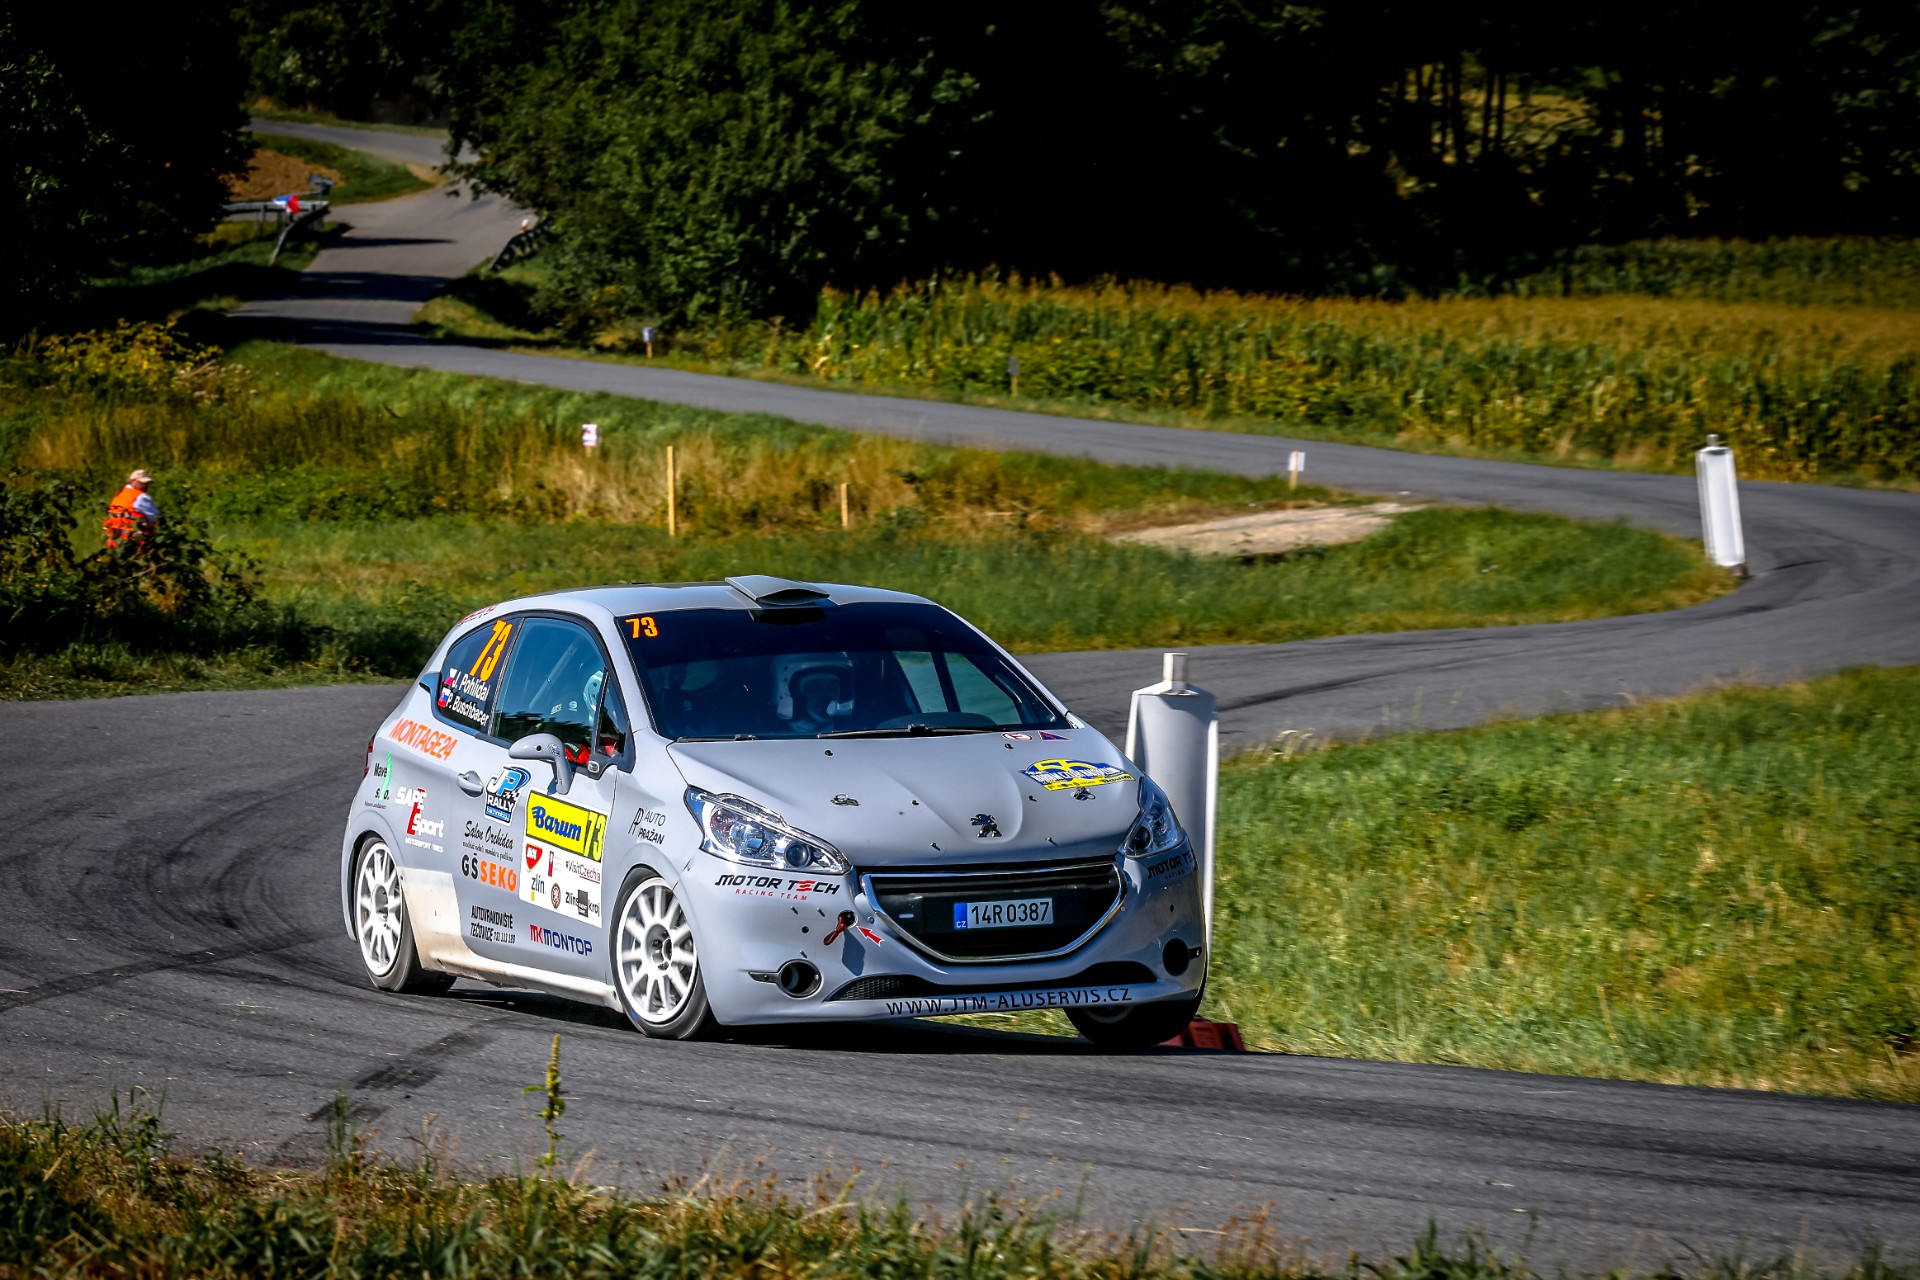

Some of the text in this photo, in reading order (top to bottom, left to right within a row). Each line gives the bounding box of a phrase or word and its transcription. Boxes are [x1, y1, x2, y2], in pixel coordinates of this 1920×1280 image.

[625, 616, 659, 638] 73
[469, 619, 513, 682] 73
[388, 717, 459, 761] MONTAGE24
[487, 794, 516, 811] RALLY
[644, 810, 666, 827] AUTO
[531, 805, 606, 862] Barum 73
[637, 827, 665, 845] PRAŽAN
[1147, 855, 1182, 879] MOTOR
[715, 874, 840, 895] MOTOR TECH
[735, 888, 808, 901] RACING TEAM
[956, 920, 967, 928] CZ
[886, 988, 1132, 1016] WWW.JTM-ALUSERVIS.CZ
